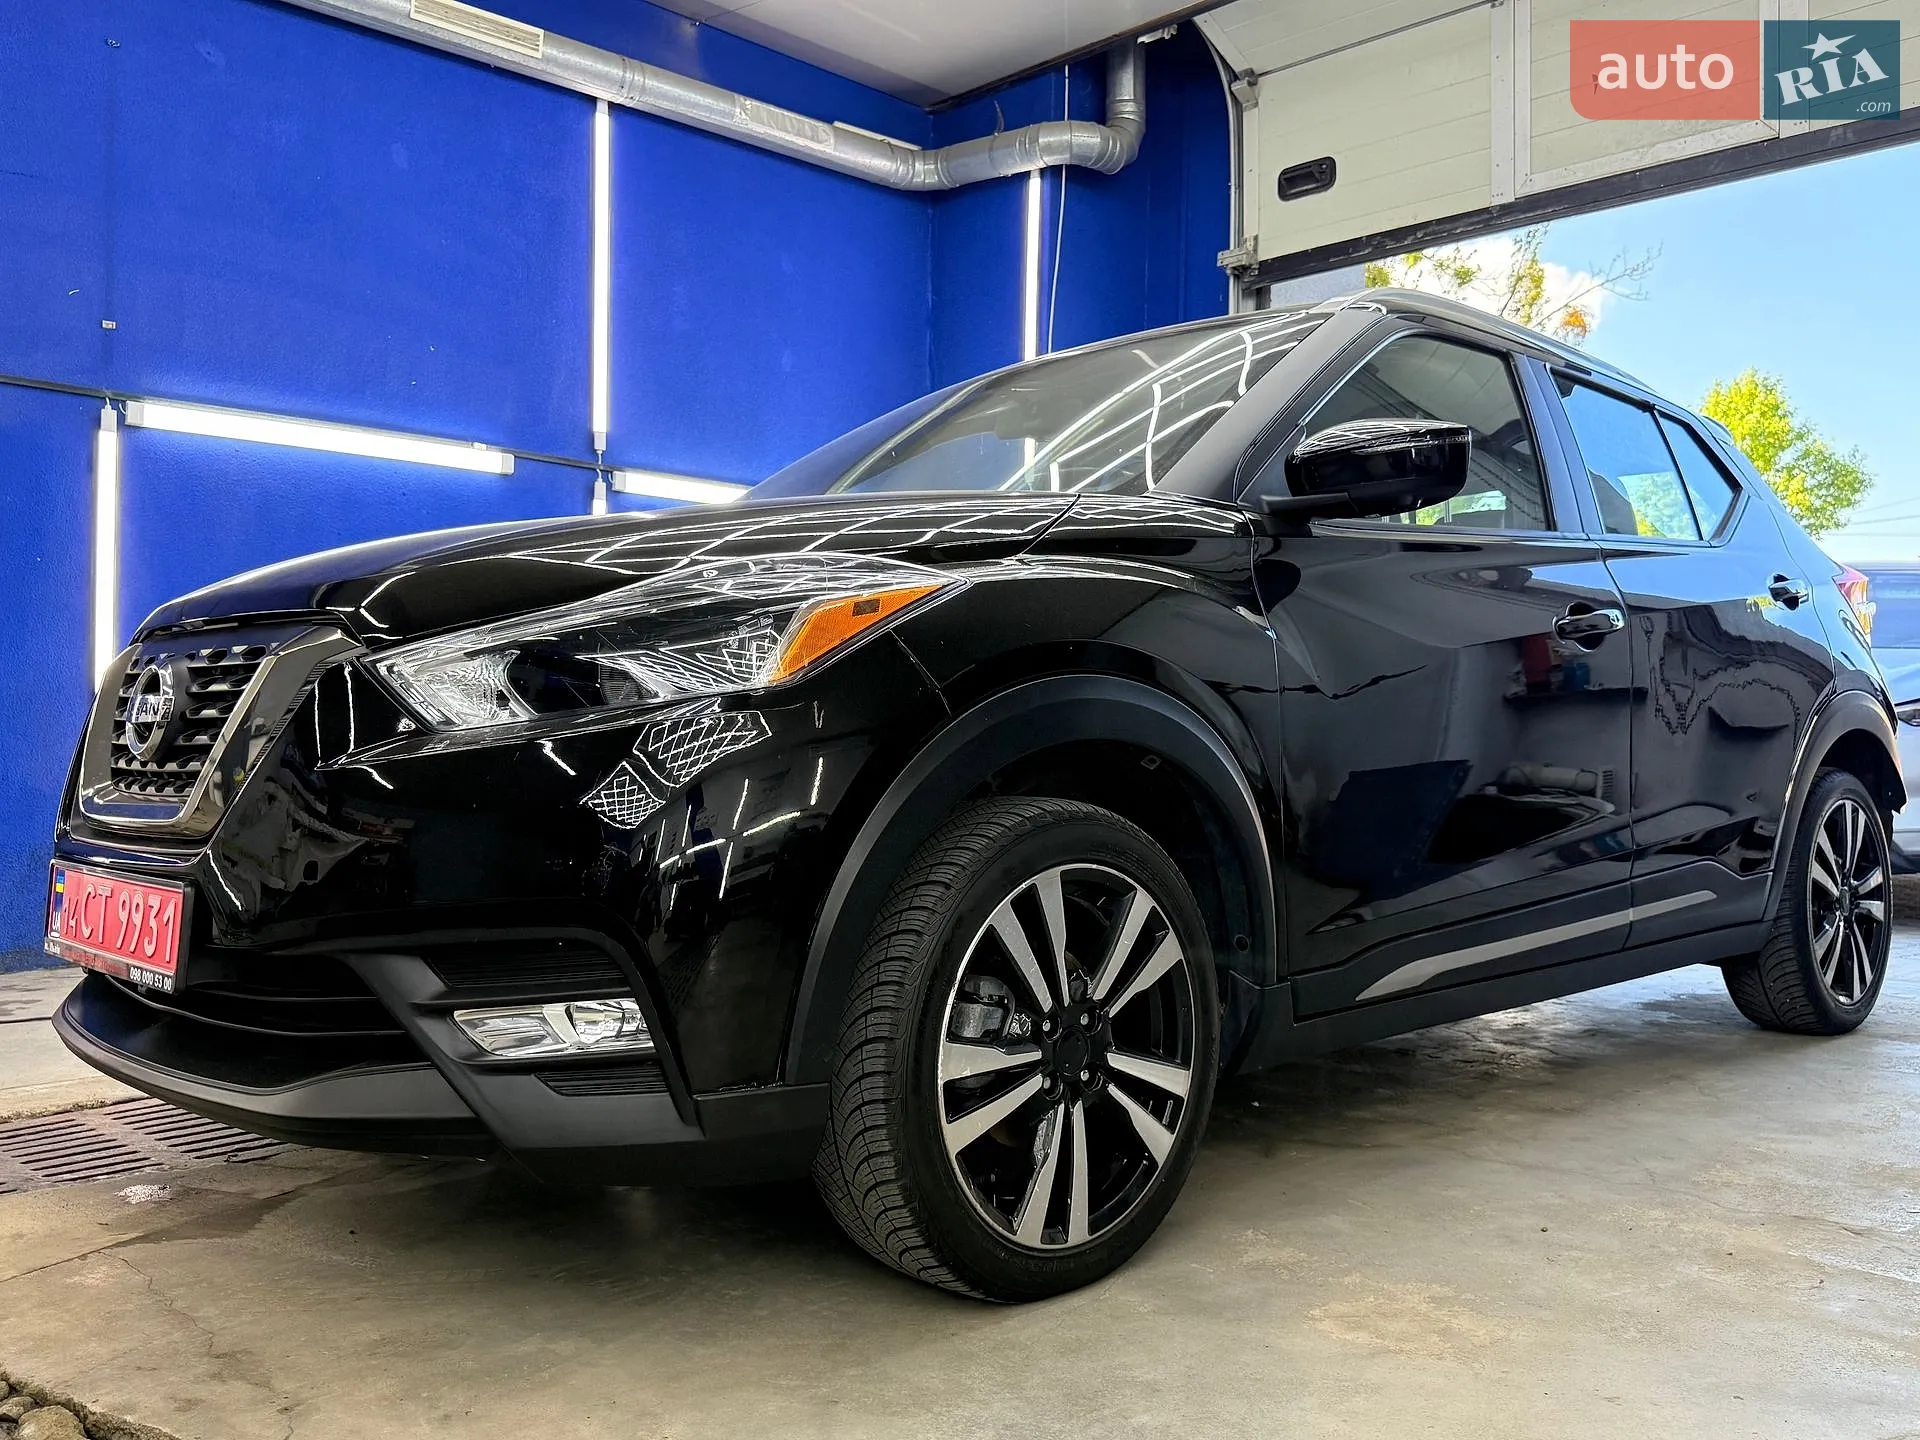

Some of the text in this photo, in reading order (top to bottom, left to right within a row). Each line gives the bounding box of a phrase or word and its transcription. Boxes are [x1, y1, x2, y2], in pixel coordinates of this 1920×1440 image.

[116, 888, 176, 963] 9931
[130, 966, 172, 991] 098 000 53 00
